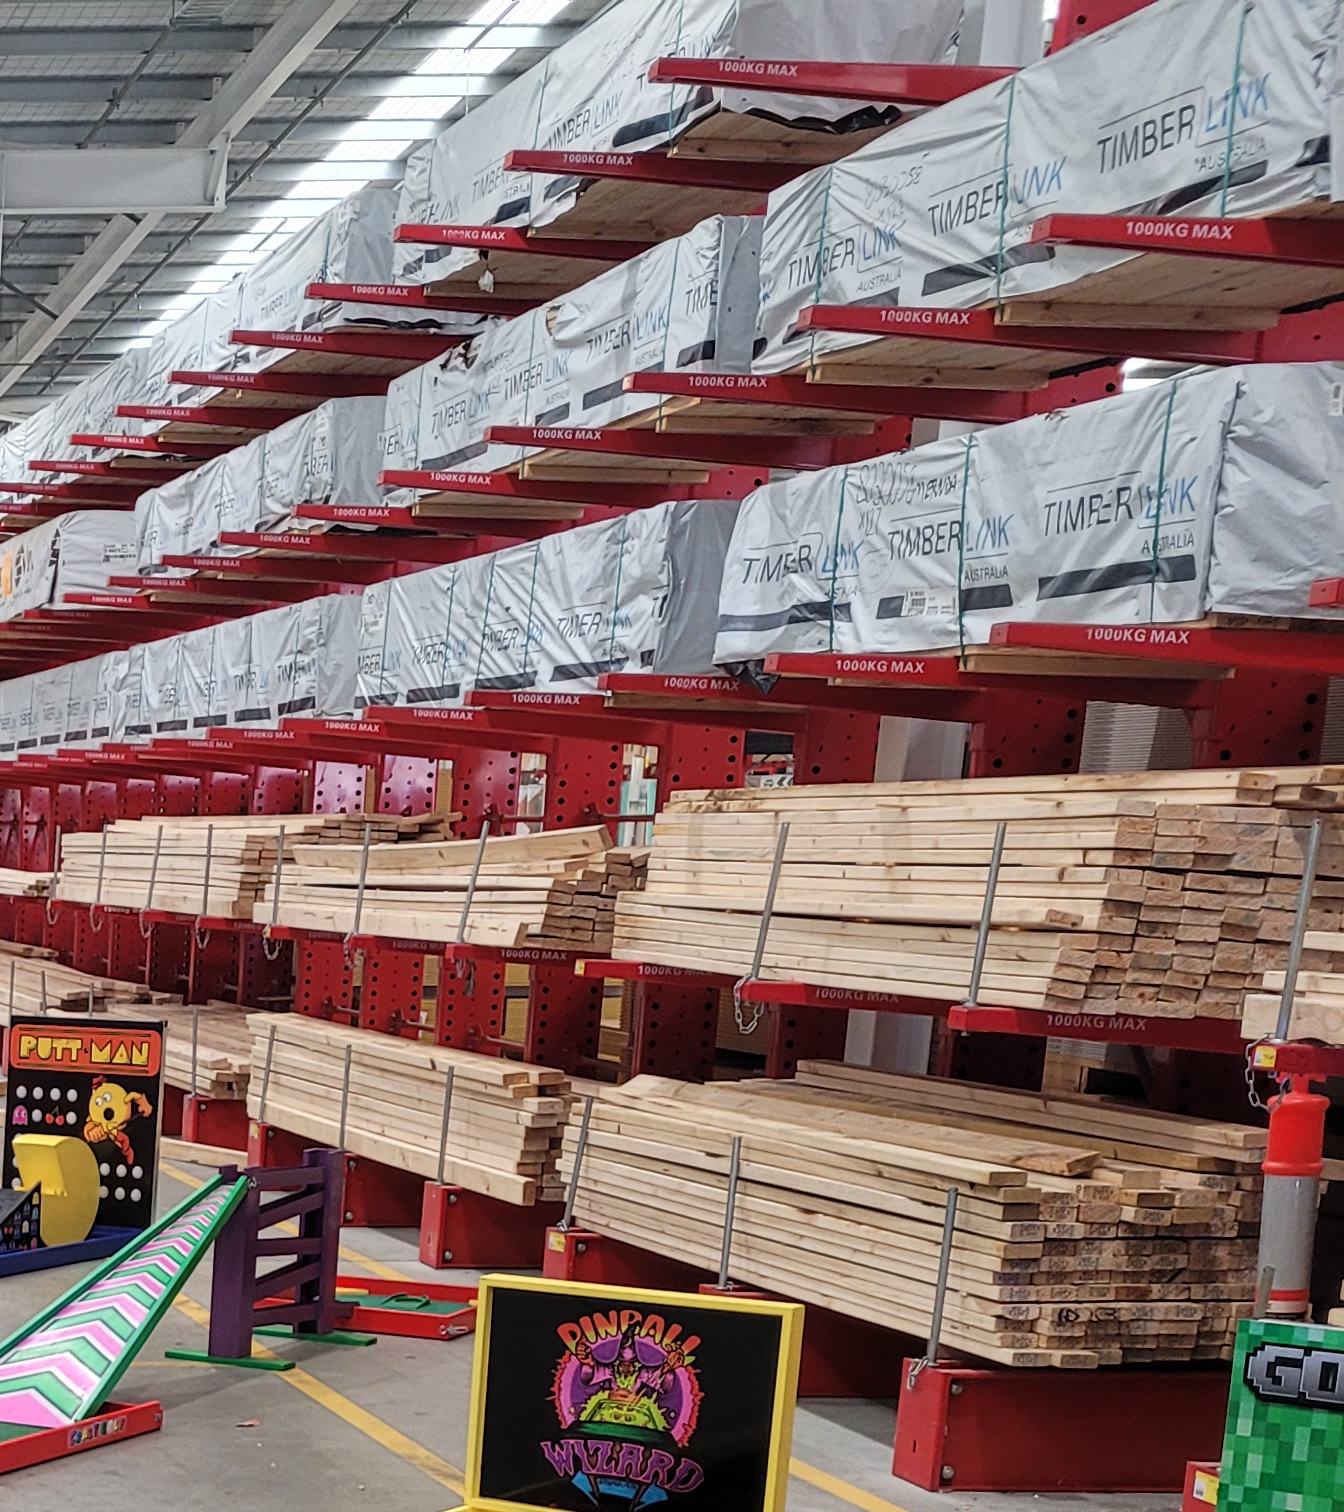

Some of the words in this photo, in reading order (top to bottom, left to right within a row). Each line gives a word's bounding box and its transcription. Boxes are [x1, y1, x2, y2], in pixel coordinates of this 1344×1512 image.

[718, 61, 765, 75] 1000KG
[767, 62, 799, 78] MAX
[1097, 104, 1196, 175] TIMBER
[1205, 71, 1273, 133] LINK
[563, 153, 604, 165] 1000KG
[606, 154, 634, 167] MAX
[441, 229, 479, 241] 1000KG
[481, 229, 506, 241] MAX
[1125, 221, 1189, 237] 1000KG
[1192, 222, 1235, 240] MAX
[787, 237, 856, 290] TIMBER
[856, 268, 903, 293] AUSTRALIA
[352, 285, 385, 296] 1000KG
[387, 285, 409, 297] MAX
[880, 309, 933, 324] 1000KG
[935, 311, 971, 326] MAX
[688, 375, 735, 388] 1000KG
[737, 377, 768, 389] MAX
[532, 428, 573, 440] 1000KG
[575, 429, 602, 441] MAX
[430, 472, 466, 483] 1000KG
[468, 473, 492, 486] MAX
[1045, 486, 1134, 537] TIMBER
[887, 520, 961, 561] TIMBER
[966, 514, 1015, 552] LINK
[964, 565, 1009, 582] AUSTRALIA
[1086, 628, 1147, 642] 1000KG
[1150, 629, 1191, 645] MAX
[835, 659, 890, 672] 1000KG
[891, 661, 925, 674] MAX
[663, 678, 704, 692] 1000KG
[707, 679, 740, 694] MAX
[512, 693, 552, 705] 1000KG
[554, 694, 581, 706] MAX
[413, 708, 449, 720] 1000KG
[450, 709, 474, 721] MAX
[324, 721, 357, 732] 1000KG
[359, 722, 380, 733] MAX
[501, 948, 539, 961] 1000KG
[541, 949, 567, 962] MAX
[1045, 1013, 1107, 1030] 1000KG
[1110, 1016, 1148, 1032] MAX
[556, 1309, 702, 1366] PINBALL
[539, 1439, 705, 1493] WIZARD
